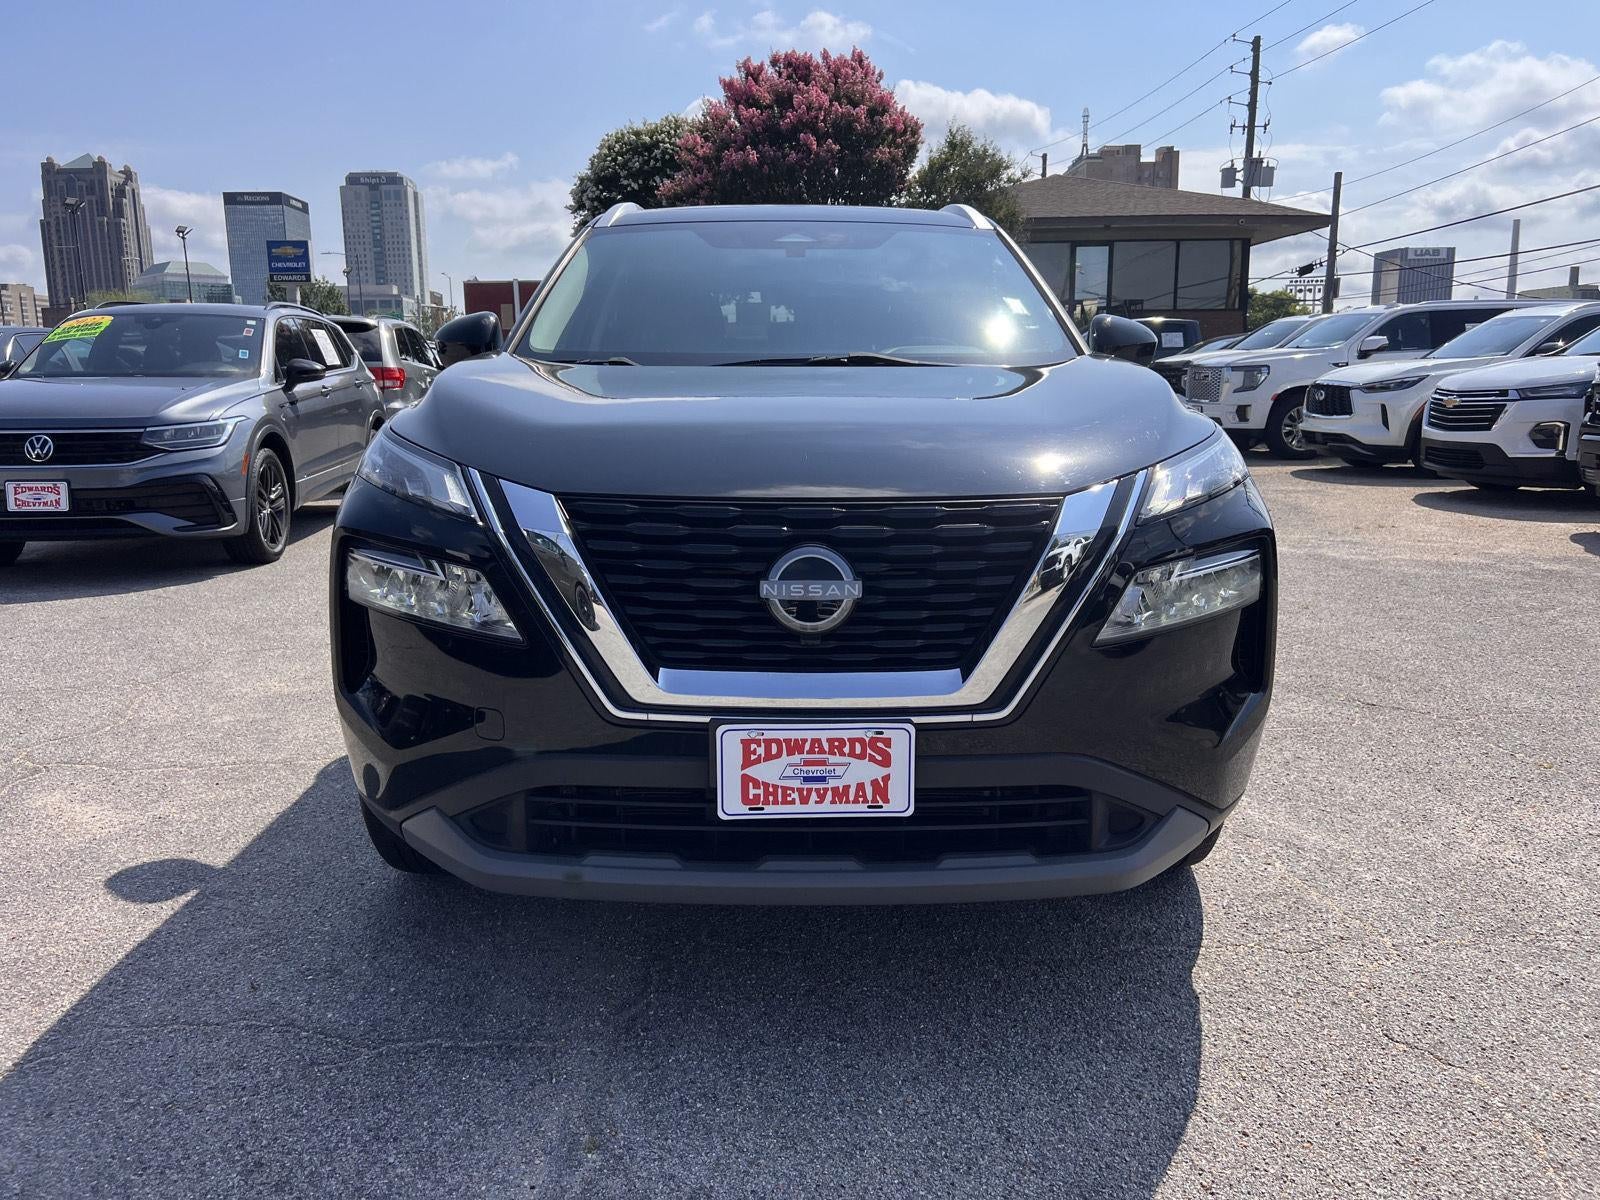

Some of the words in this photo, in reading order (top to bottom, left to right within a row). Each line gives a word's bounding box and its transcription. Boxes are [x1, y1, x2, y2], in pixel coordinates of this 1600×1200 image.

[1414, 249, 1441, 257] UAB
[13, 486, 61, 497] EDWARDS
[14, 497, 61, 508] CHEVYMAN
[763, 583, 859, 597] NISSAN
[740, 736, 892, 771] EDWARDS
[792, 766, 836, 776] Chevrolet
[740, 773, 891, 806] CHEVYMAN
